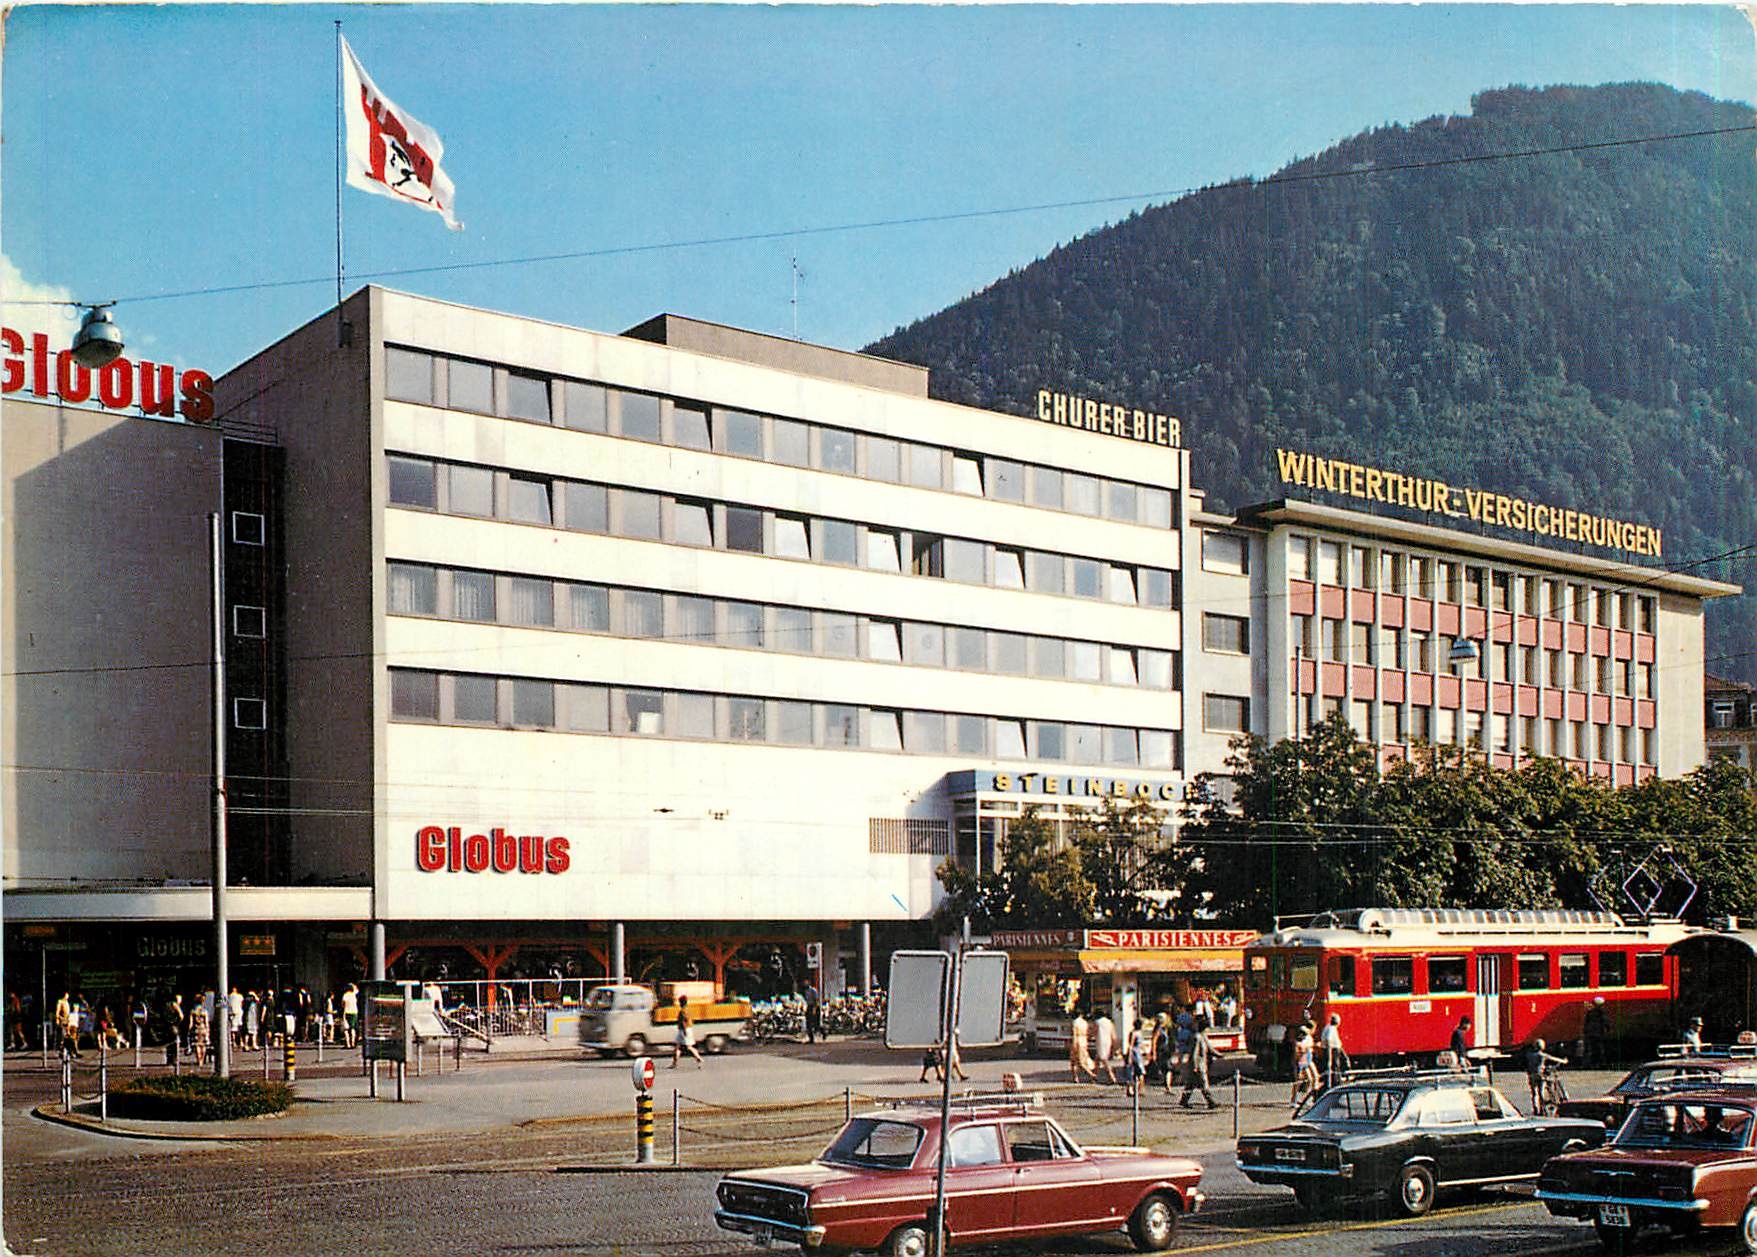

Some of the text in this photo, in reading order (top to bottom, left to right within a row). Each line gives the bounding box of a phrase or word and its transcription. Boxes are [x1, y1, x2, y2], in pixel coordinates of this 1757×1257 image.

[1038, 389, 1181, 448] CHURER BIER
[416, 826, 571, 875] Globus
[1118, 931, 1232, 947] PARISIENNES
